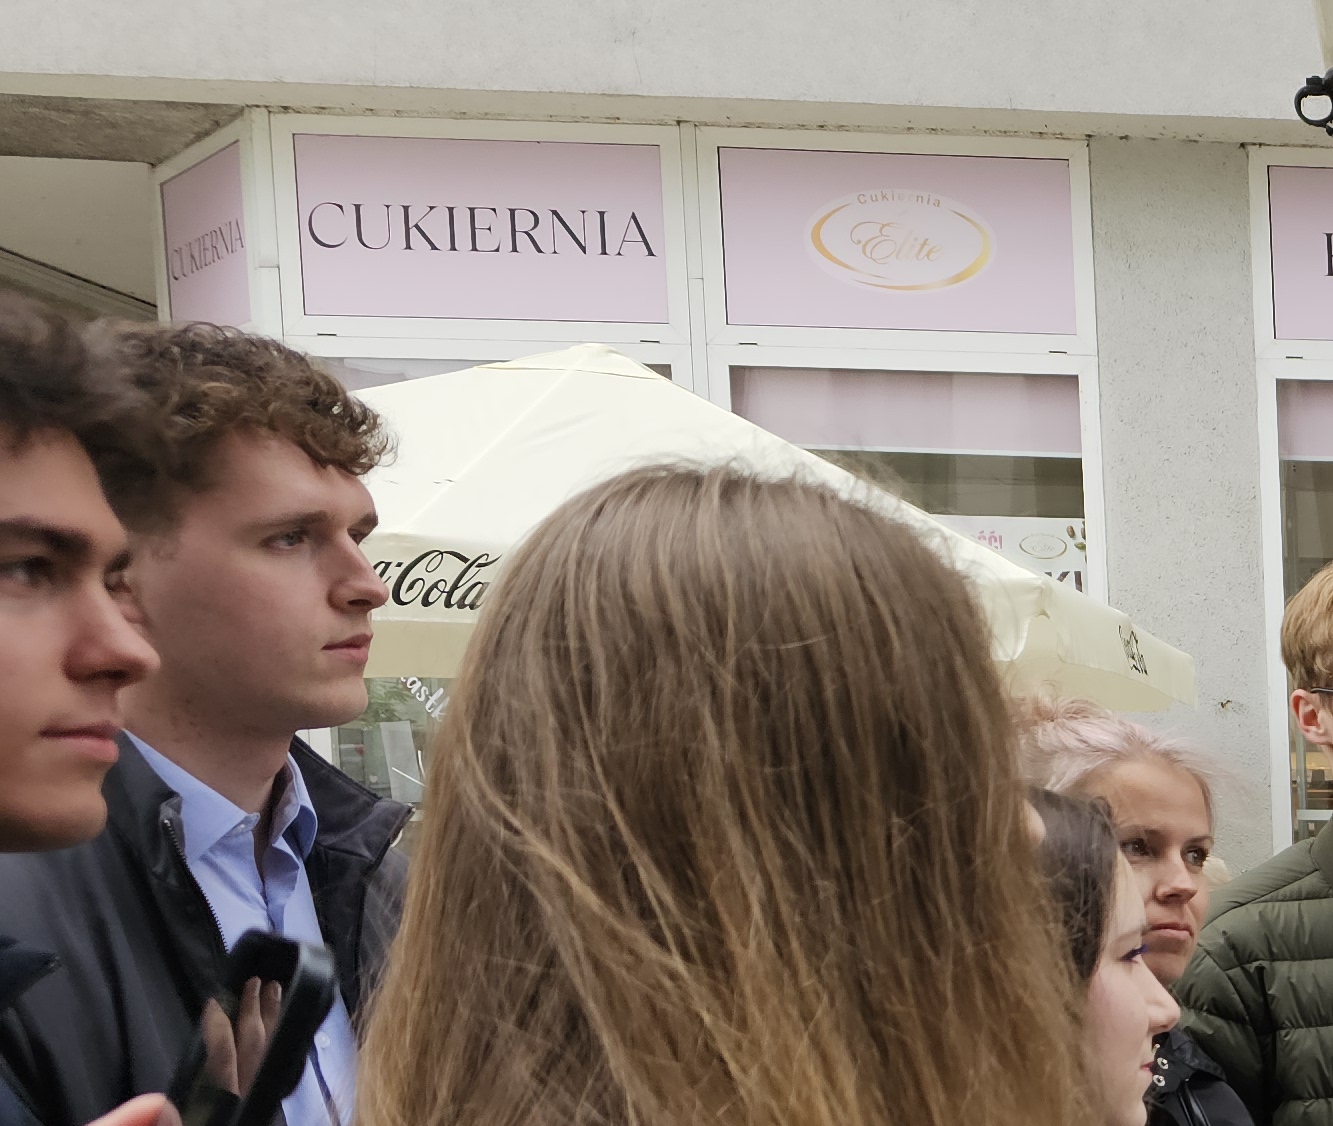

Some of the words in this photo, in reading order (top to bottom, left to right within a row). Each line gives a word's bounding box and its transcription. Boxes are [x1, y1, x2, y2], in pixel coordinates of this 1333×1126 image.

[856, 190, 942, 208] Cukiernia
[169, 217, 245, 282] CUKIERNIA
[307, 201, 658, 257] CUKIERNIA
